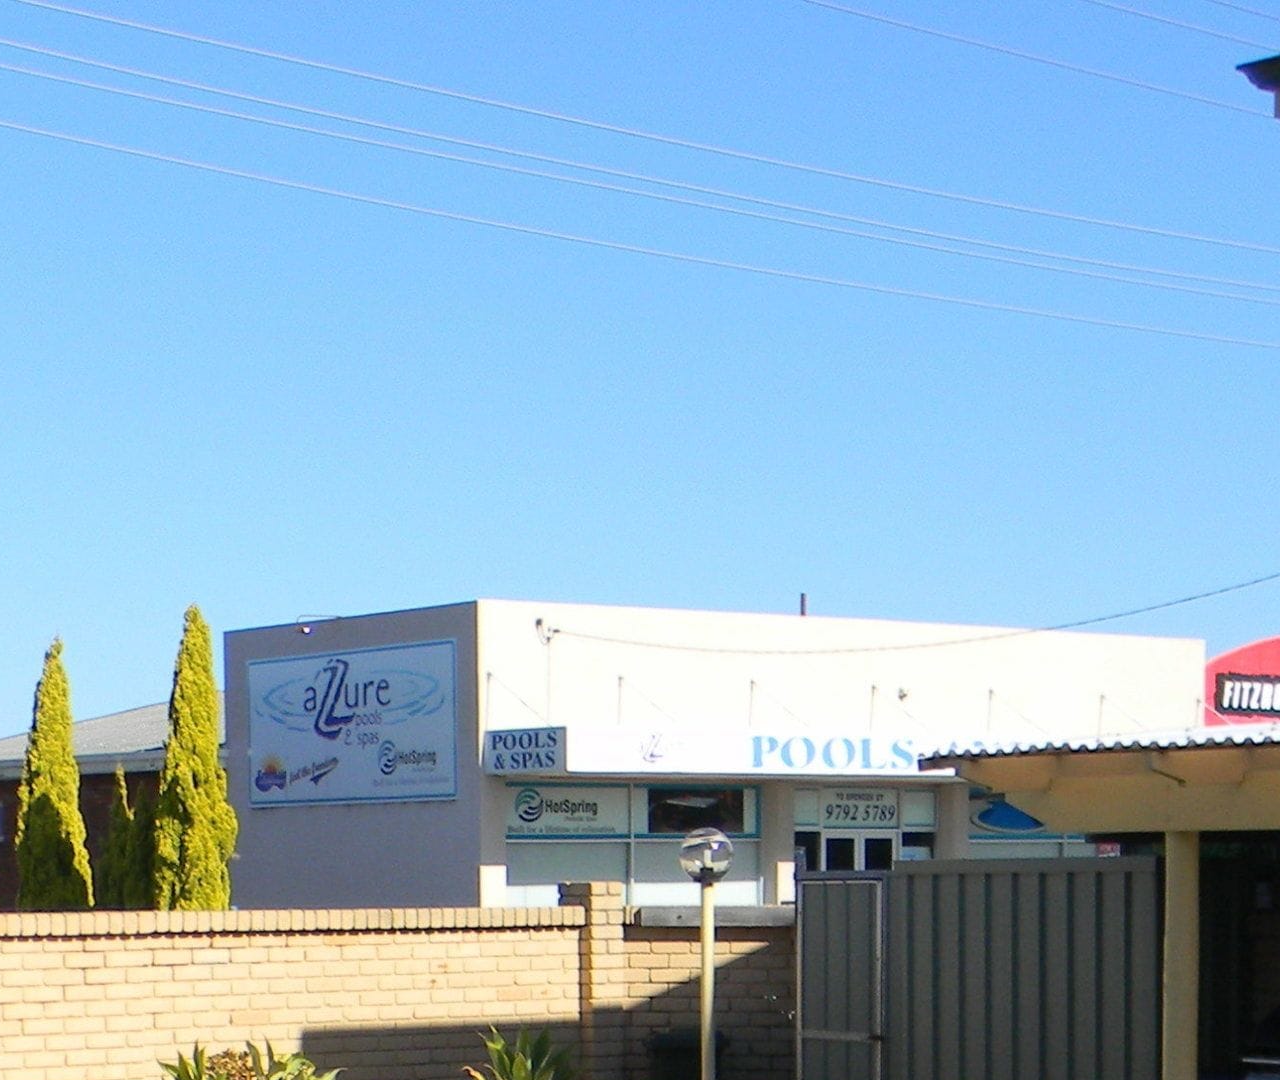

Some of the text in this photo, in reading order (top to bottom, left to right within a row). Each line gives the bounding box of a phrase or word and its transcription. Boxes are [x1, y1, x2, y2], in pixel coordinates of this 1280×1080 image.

[492, 731, 557, 750] POOLS
[494, 751, 555, 770] & SPAS
[751, 736, 915, 770] POOLS
[545, 800, 598, 815] HotSpring
[826, 804, 896, 821] 9792 5789
